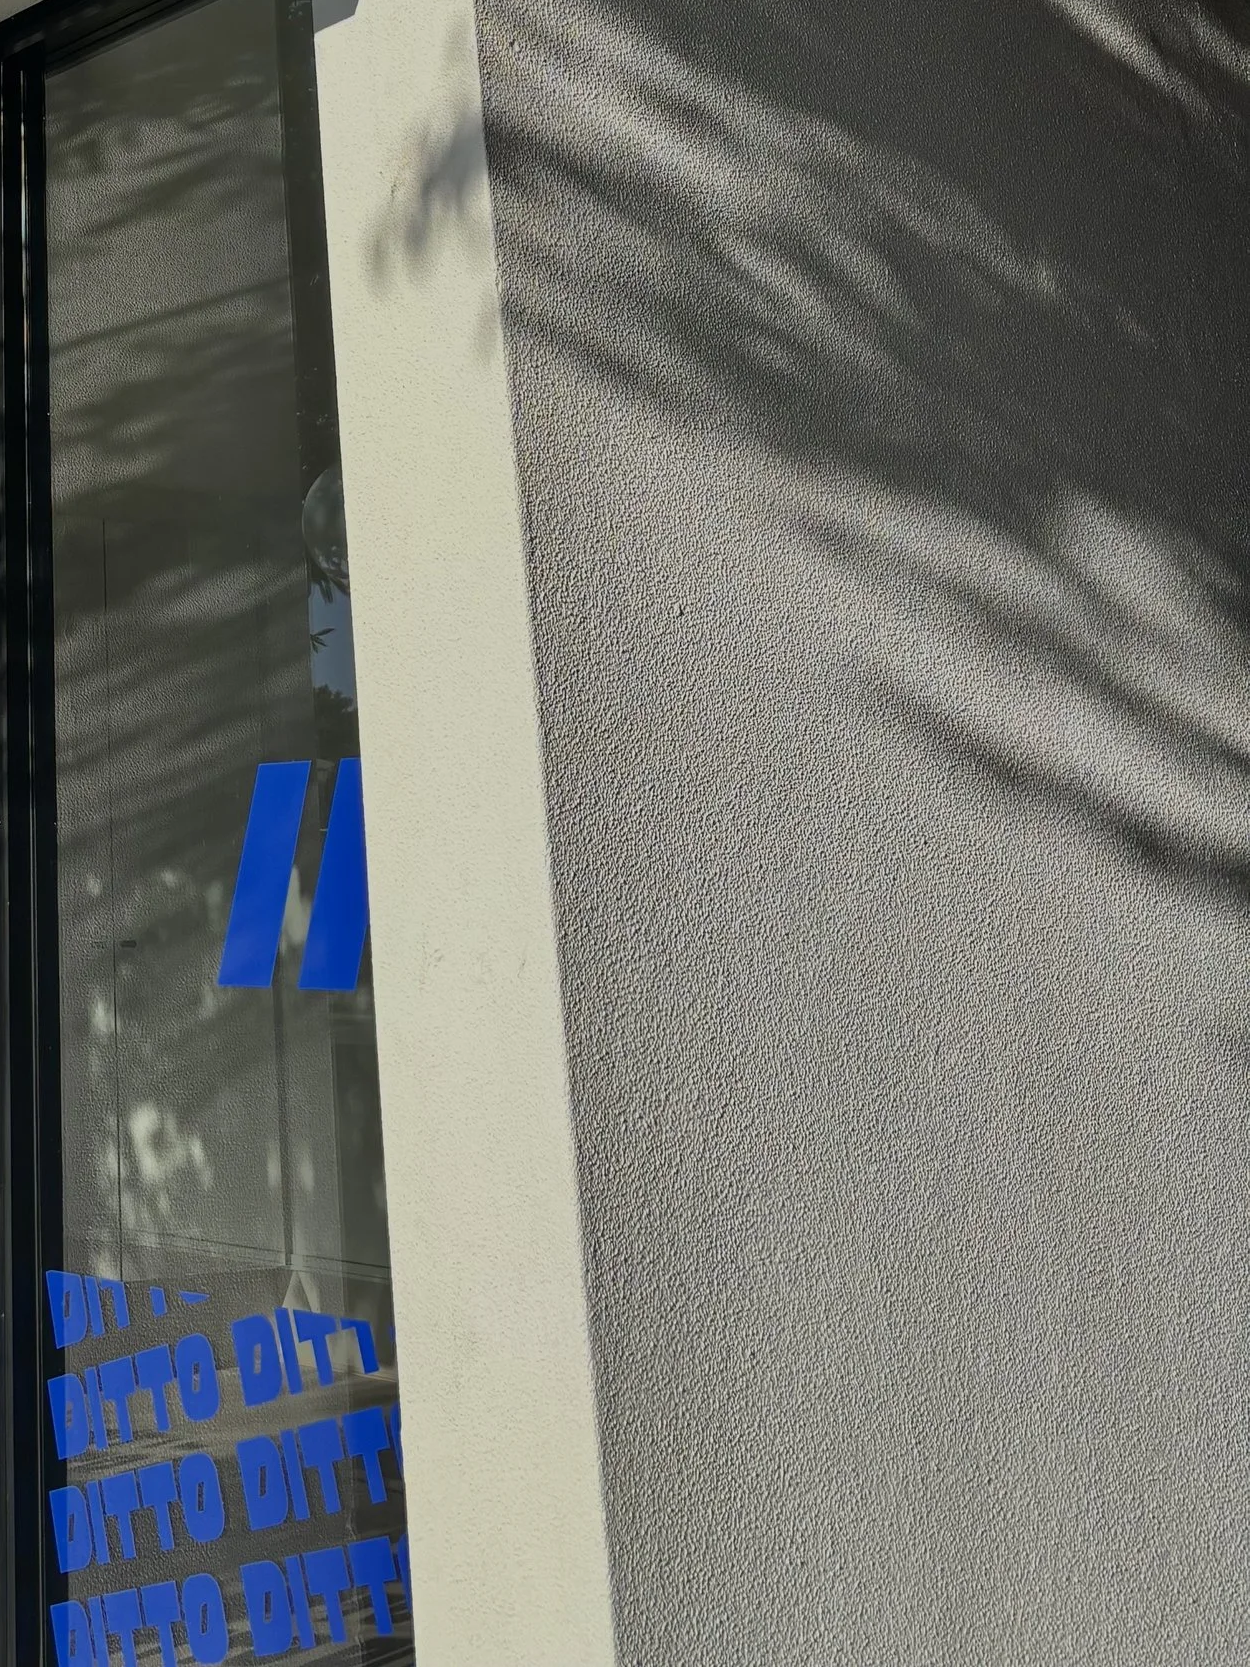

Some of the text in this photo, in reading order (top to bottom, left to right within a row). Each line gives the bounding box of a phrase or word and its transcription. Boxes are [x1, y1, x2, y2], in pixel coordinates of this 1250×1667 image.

[47, 1307, 396, 1460] DITTO DITT
[49, 1404, 402, 1573] DITTO DITT
[50, 1534, 412, 1667] DITTO DITT
